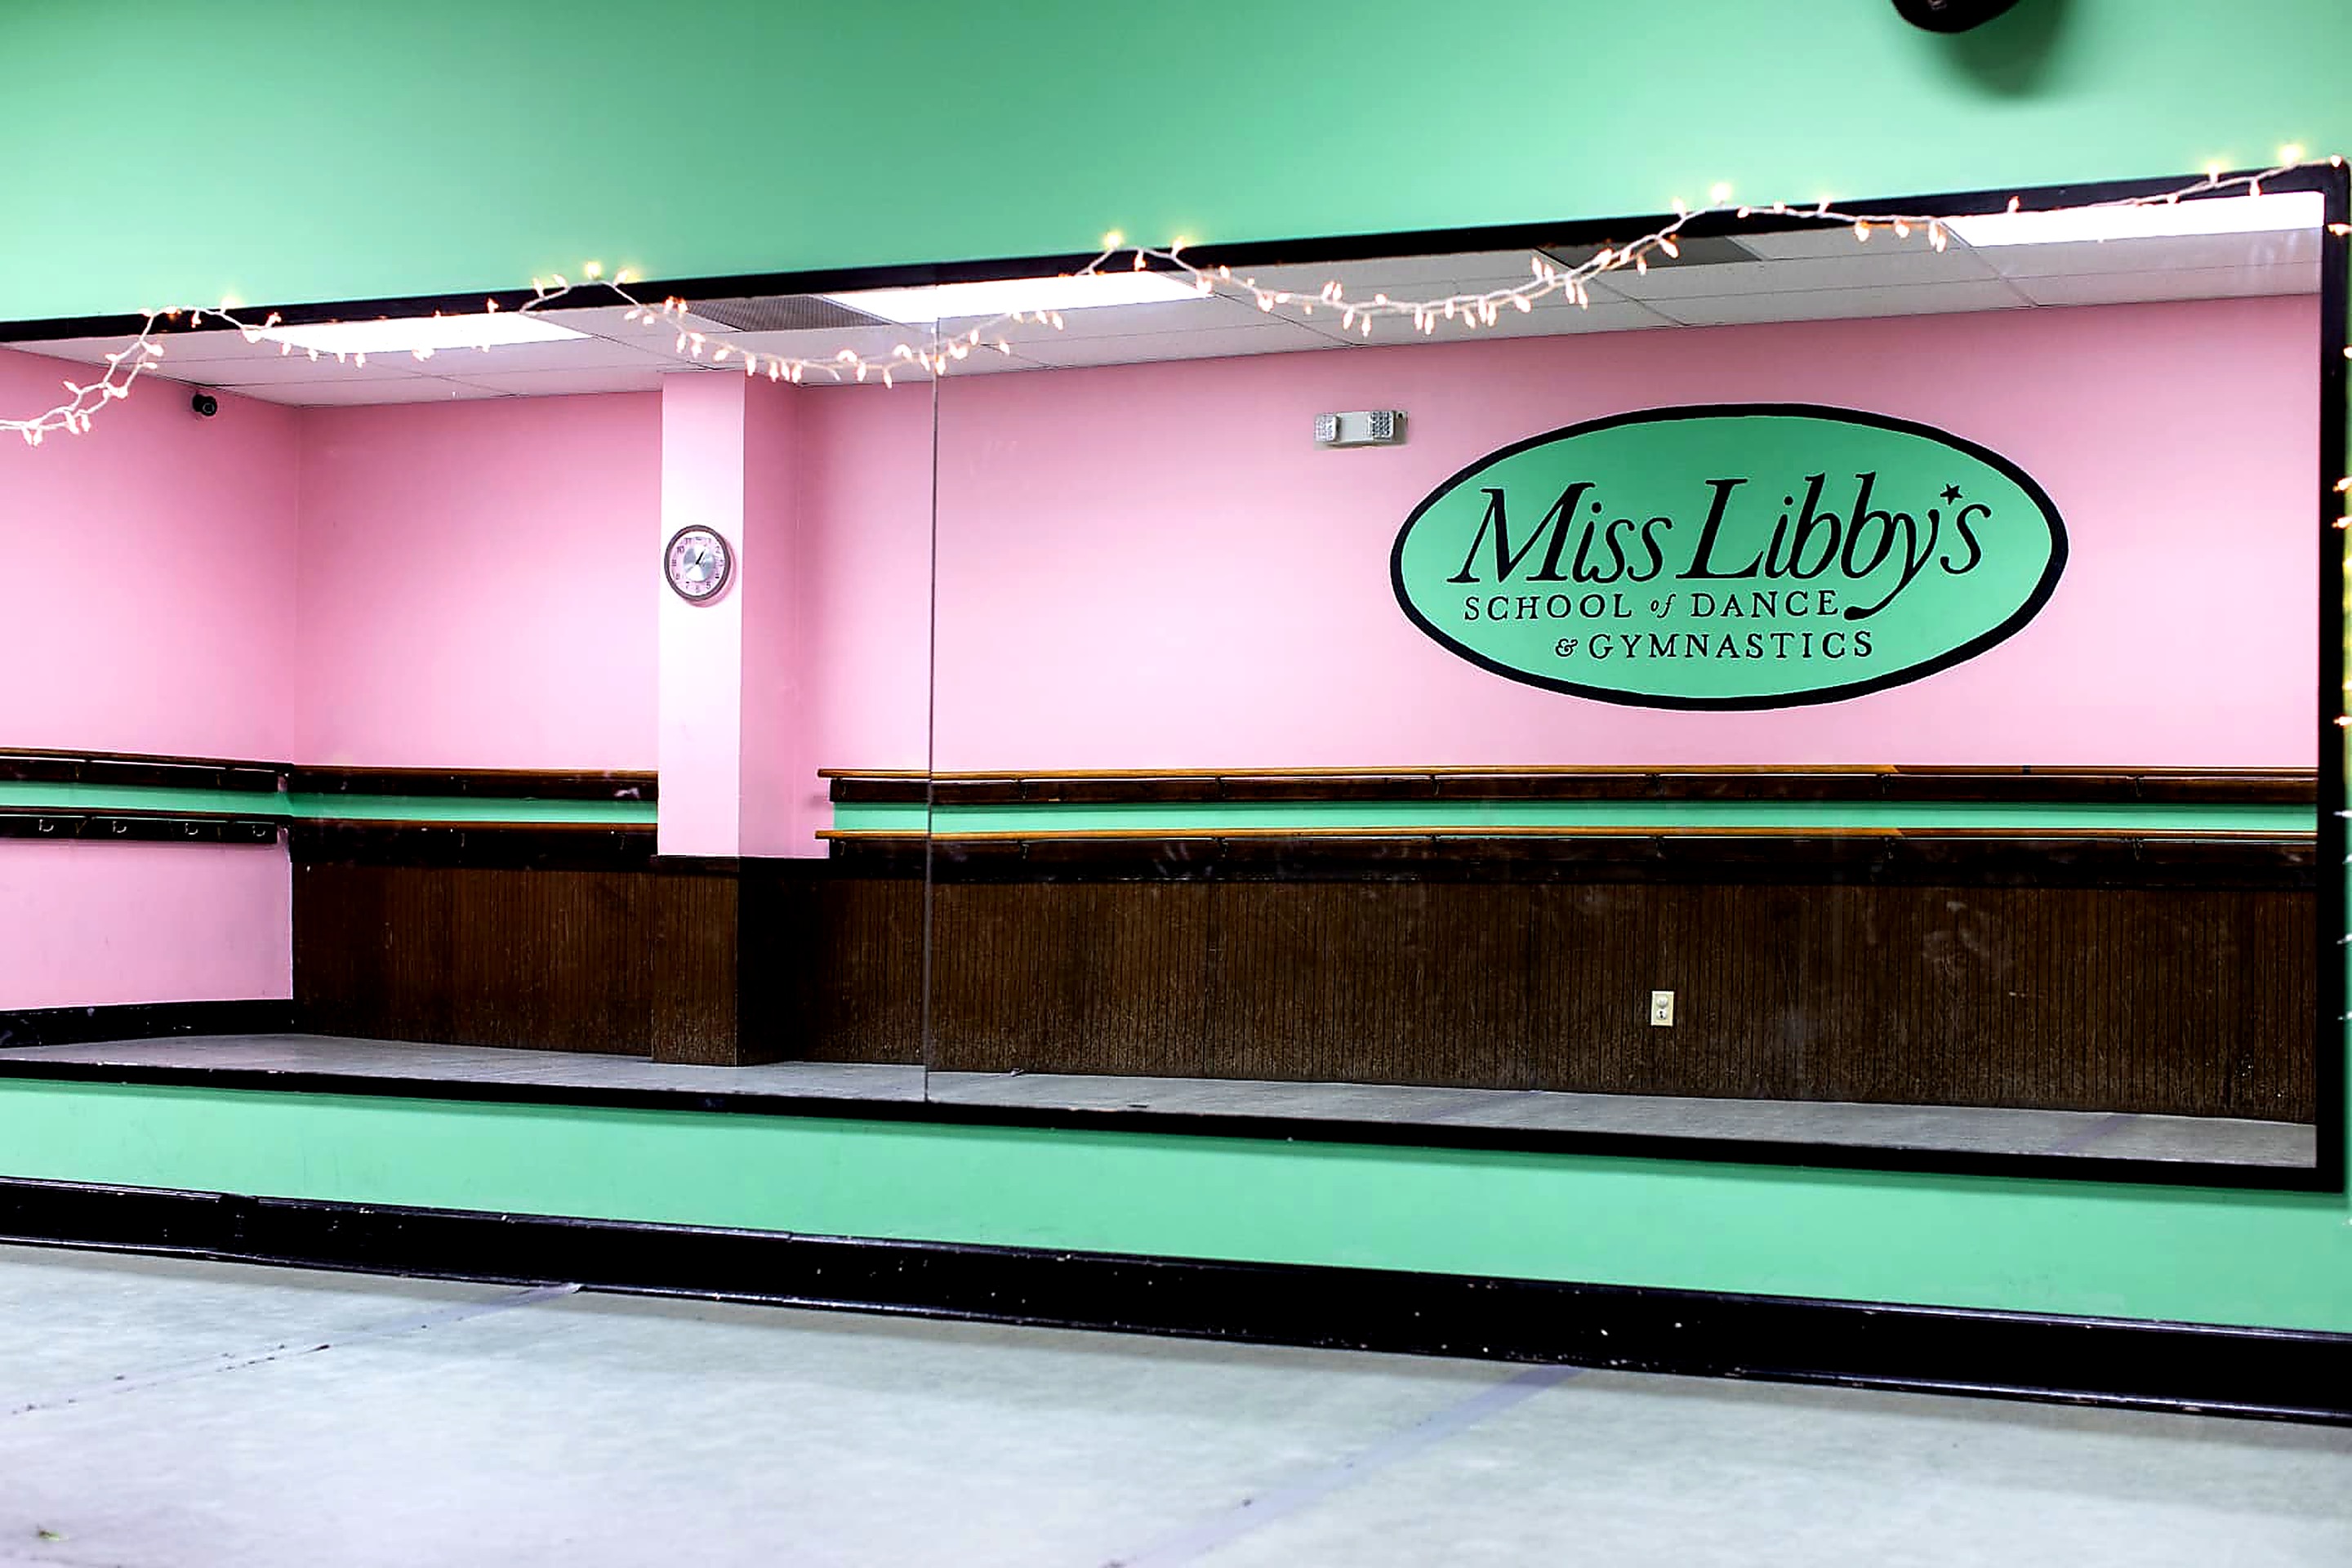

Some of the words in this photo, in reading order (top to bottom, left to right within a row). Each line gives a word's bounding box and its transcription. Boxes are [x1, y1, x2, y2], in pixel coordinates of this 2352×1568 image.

[1446, 482, 1673, 584] Miss
[1463, 593, 1633, 621] SCHOOL
[1650, 592, 1677, 618] of
[1690, 590, 1839, 618] DANCE
[1554, 637, 1579, 658] &
[1588, 630, 1873, 660] GYMNASTICS
